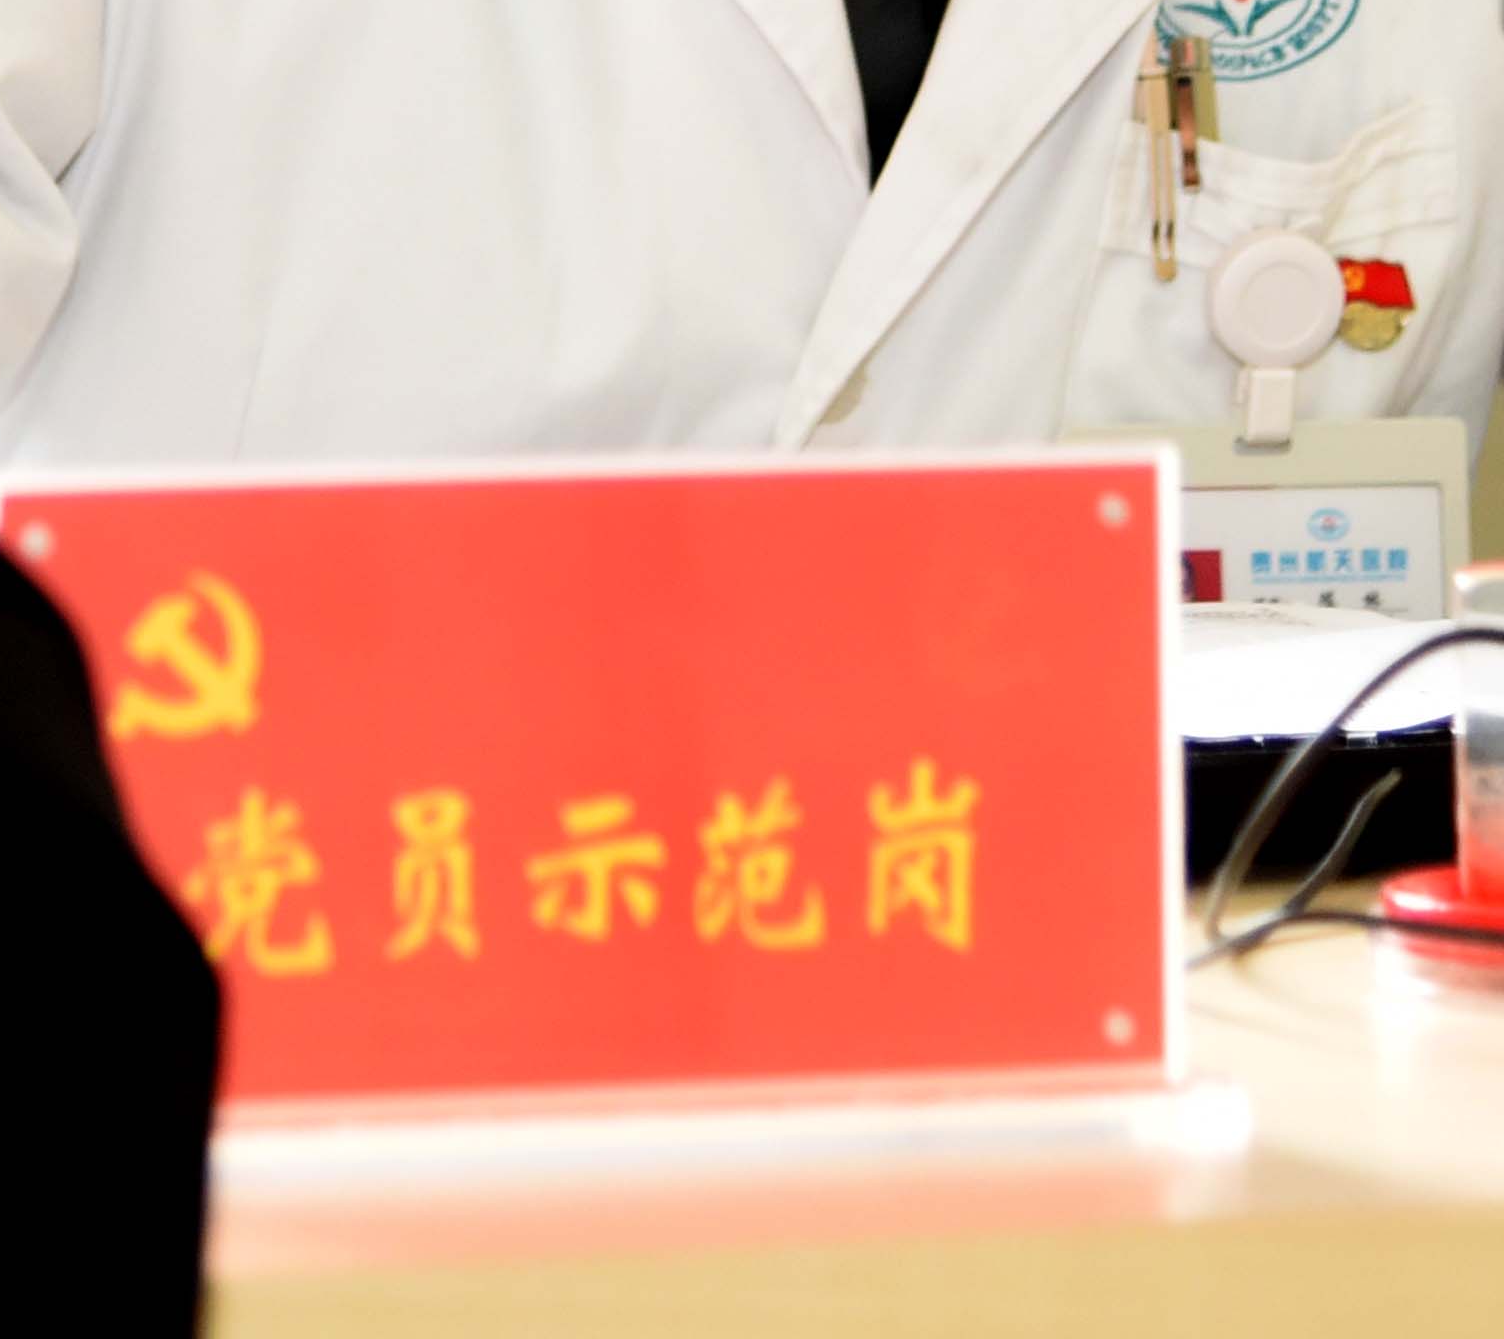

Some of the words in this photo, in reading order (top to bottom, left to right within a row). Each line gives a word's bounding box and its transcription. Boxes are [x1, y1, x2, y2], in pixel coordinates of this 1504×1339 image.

[186, 759, 981, 975] 党员示范岗
